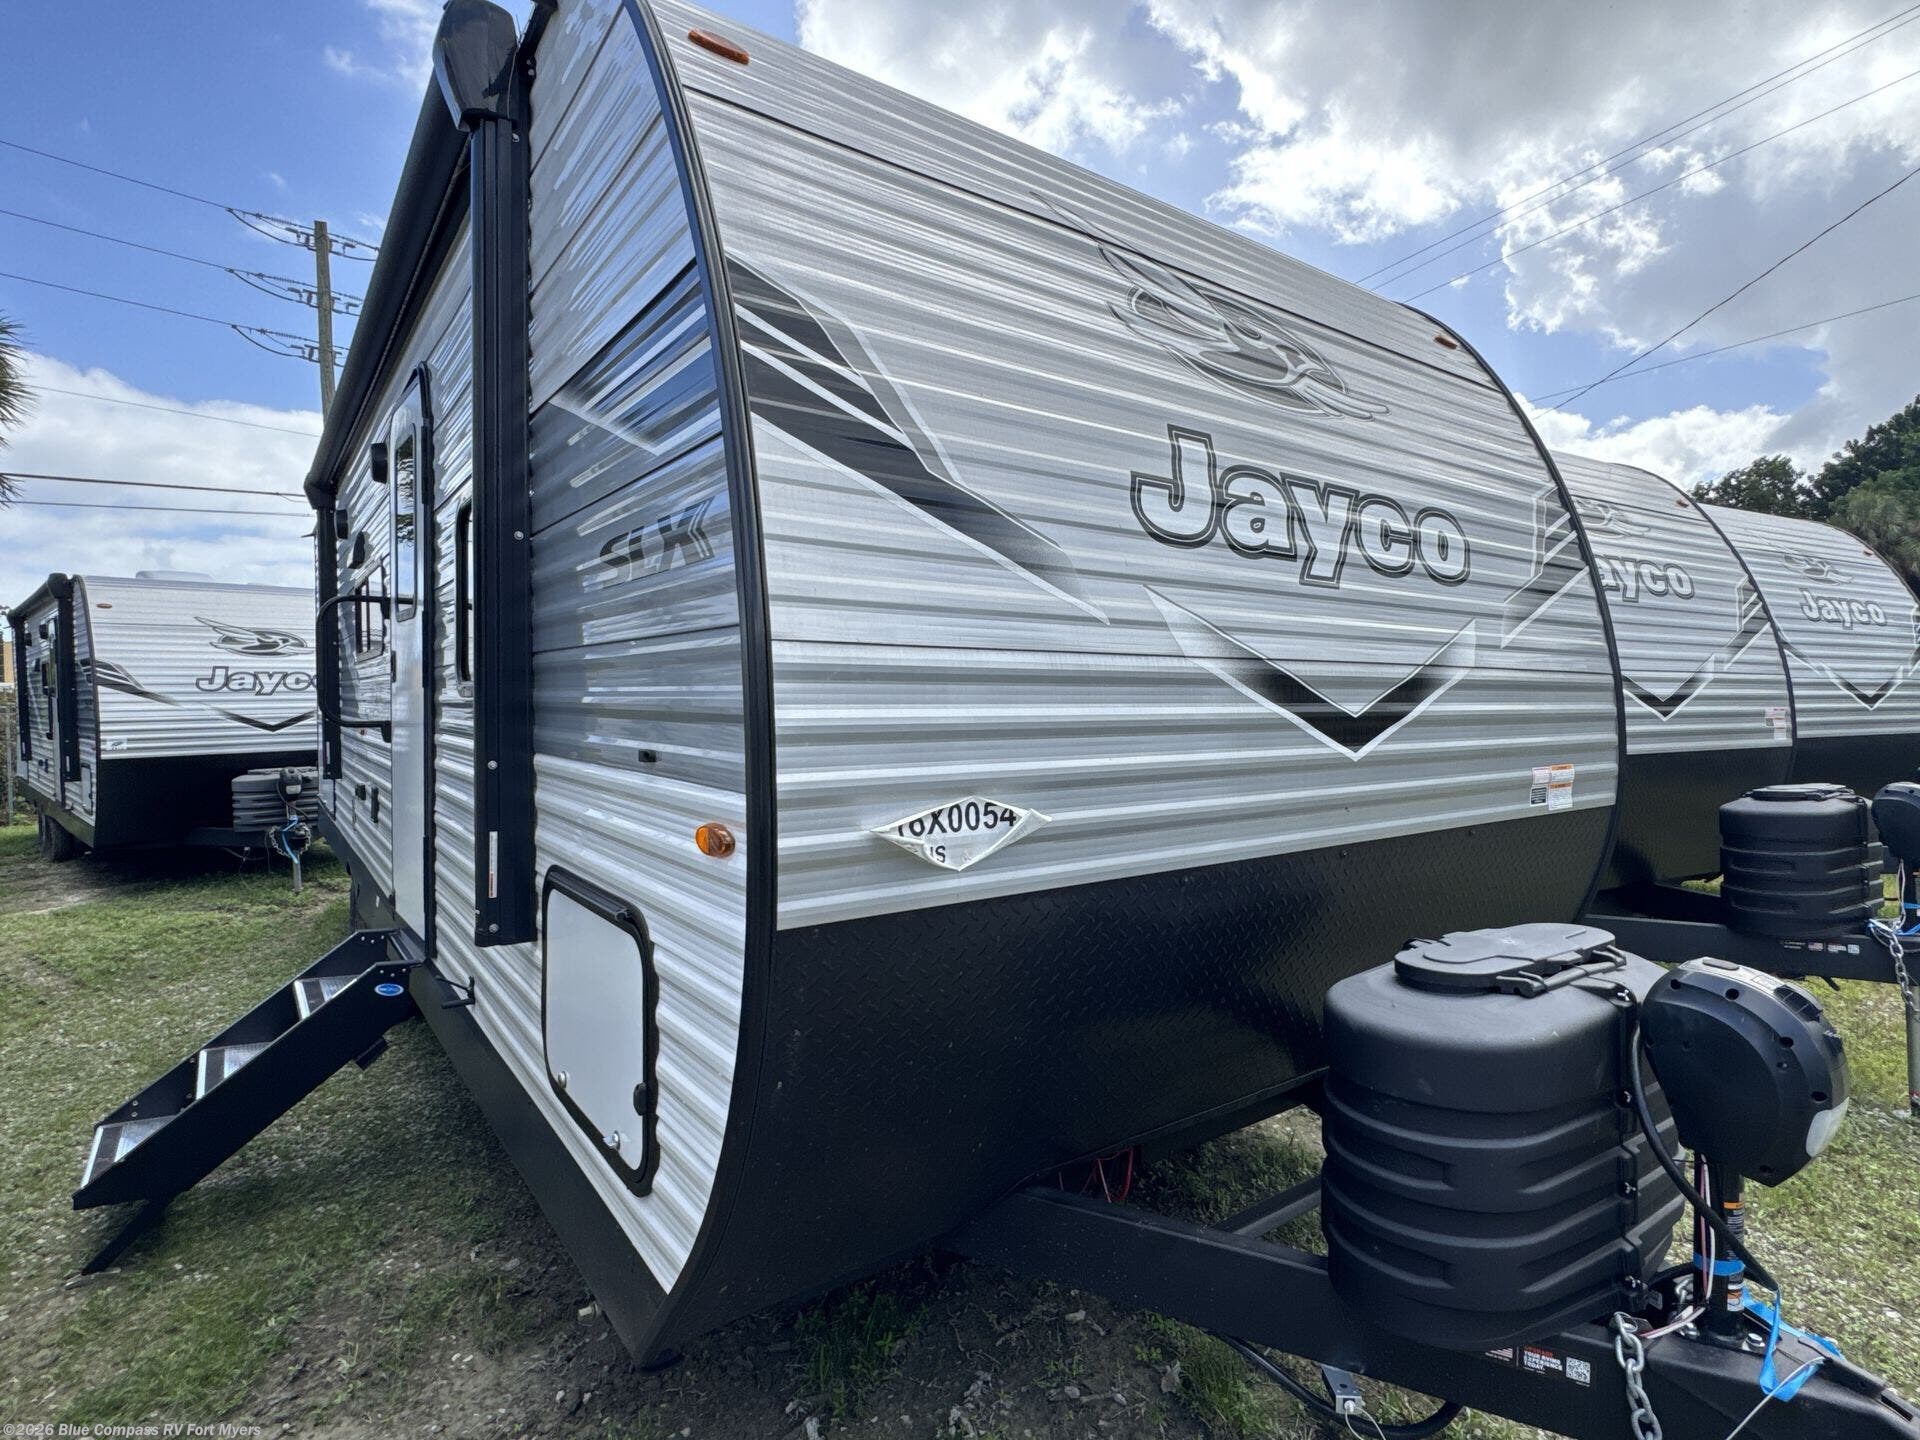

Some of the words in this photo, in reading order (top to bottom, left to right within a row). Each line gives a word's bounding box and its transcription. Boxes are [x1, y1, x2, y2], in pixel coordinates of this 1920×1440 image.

[1130, 424, 1471, 589] Jayco
[1594, 554, 1696, 603] ayco
[1799, 588, 1888, 630] Jayco
[195, 666, 317, 696] Jayc
